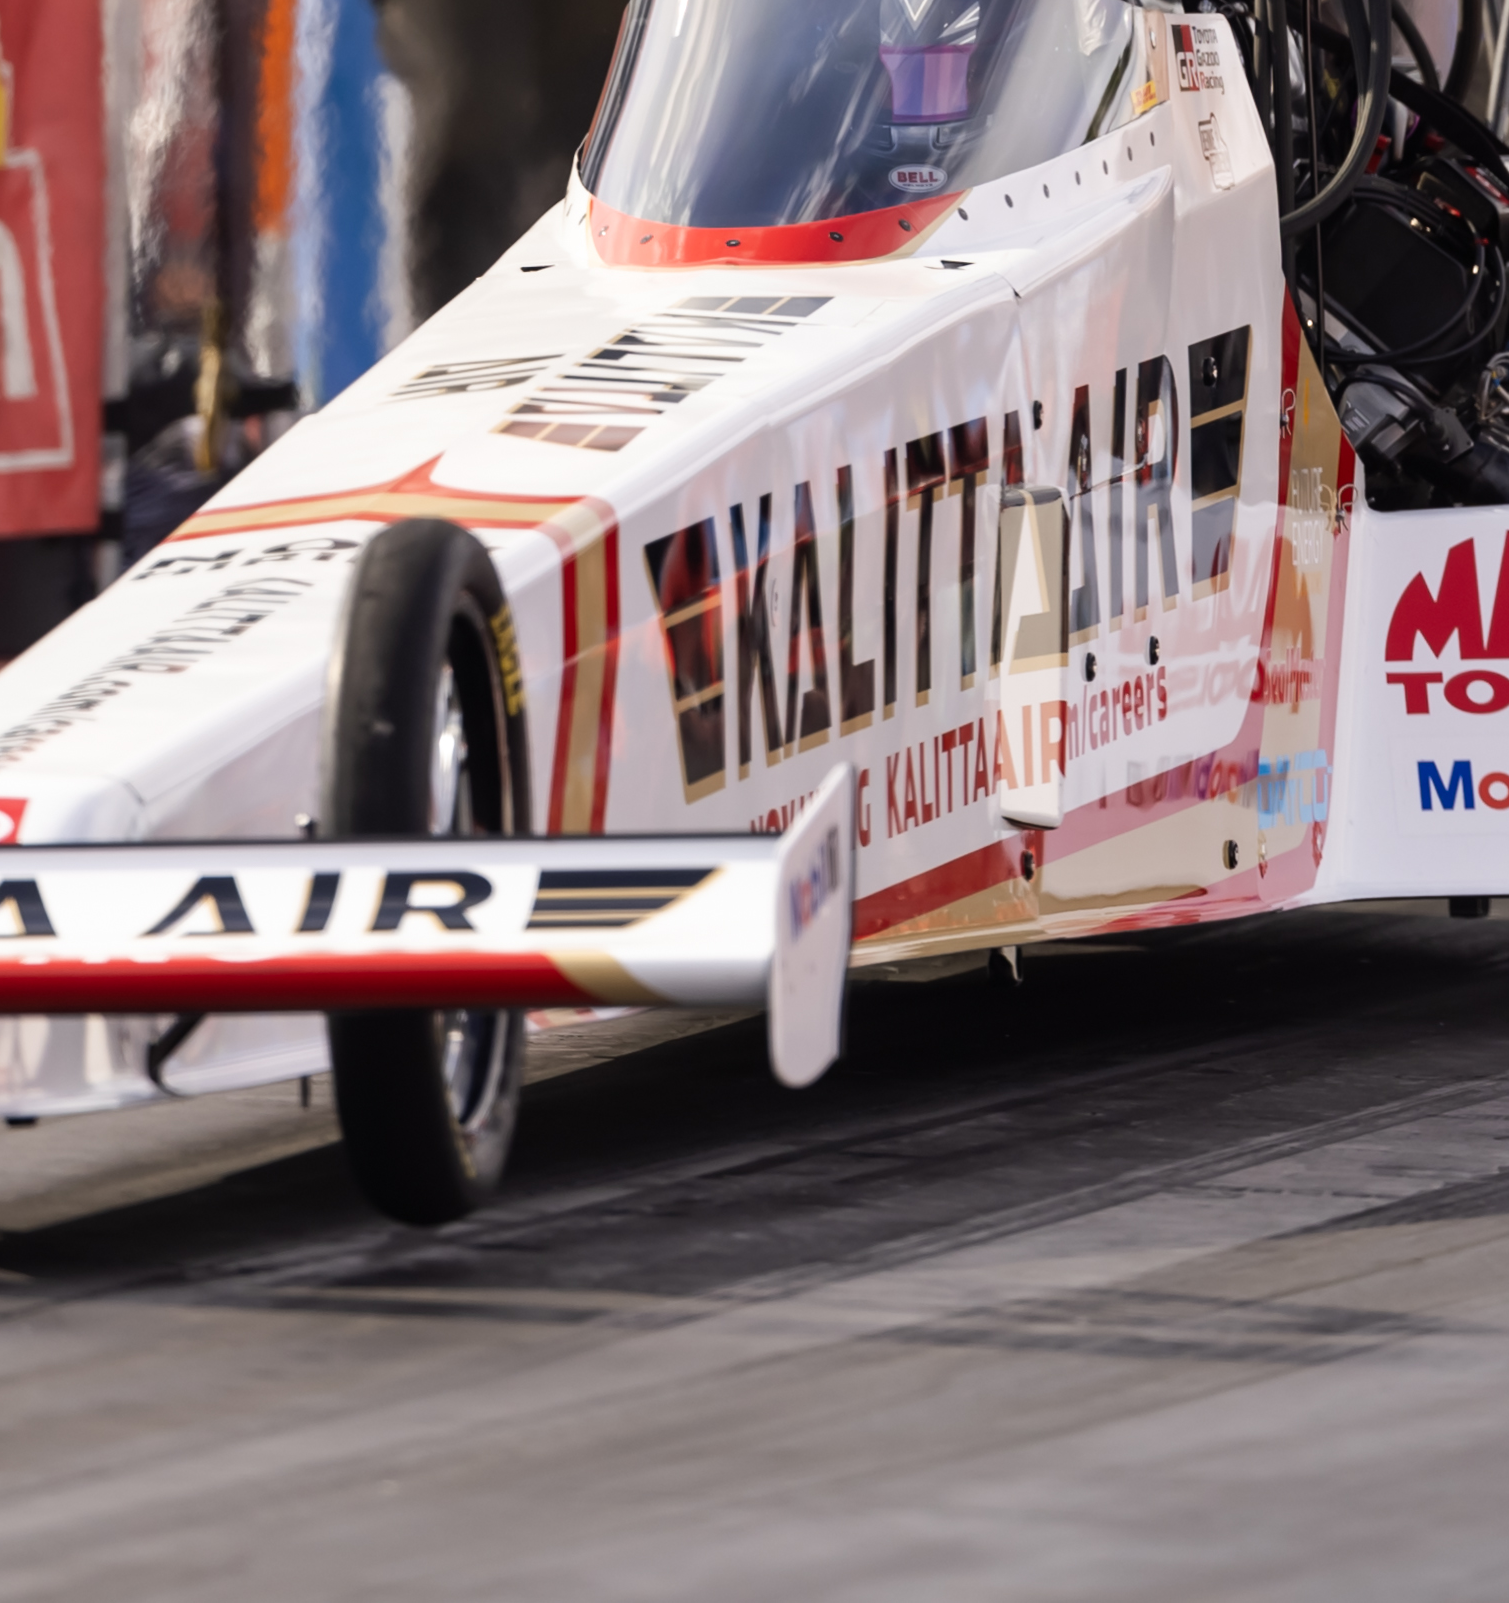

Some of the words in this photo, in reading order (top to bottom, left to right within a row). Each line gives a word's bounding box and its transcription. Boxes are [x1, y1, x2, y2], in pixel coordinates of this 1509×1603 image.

[897, 171, 939, 183] BELL
[728, 410, 1069, 784] KALITTA
[1067, 354, 1181, 648] AIR
[136, 868, 498, 941] AIR
